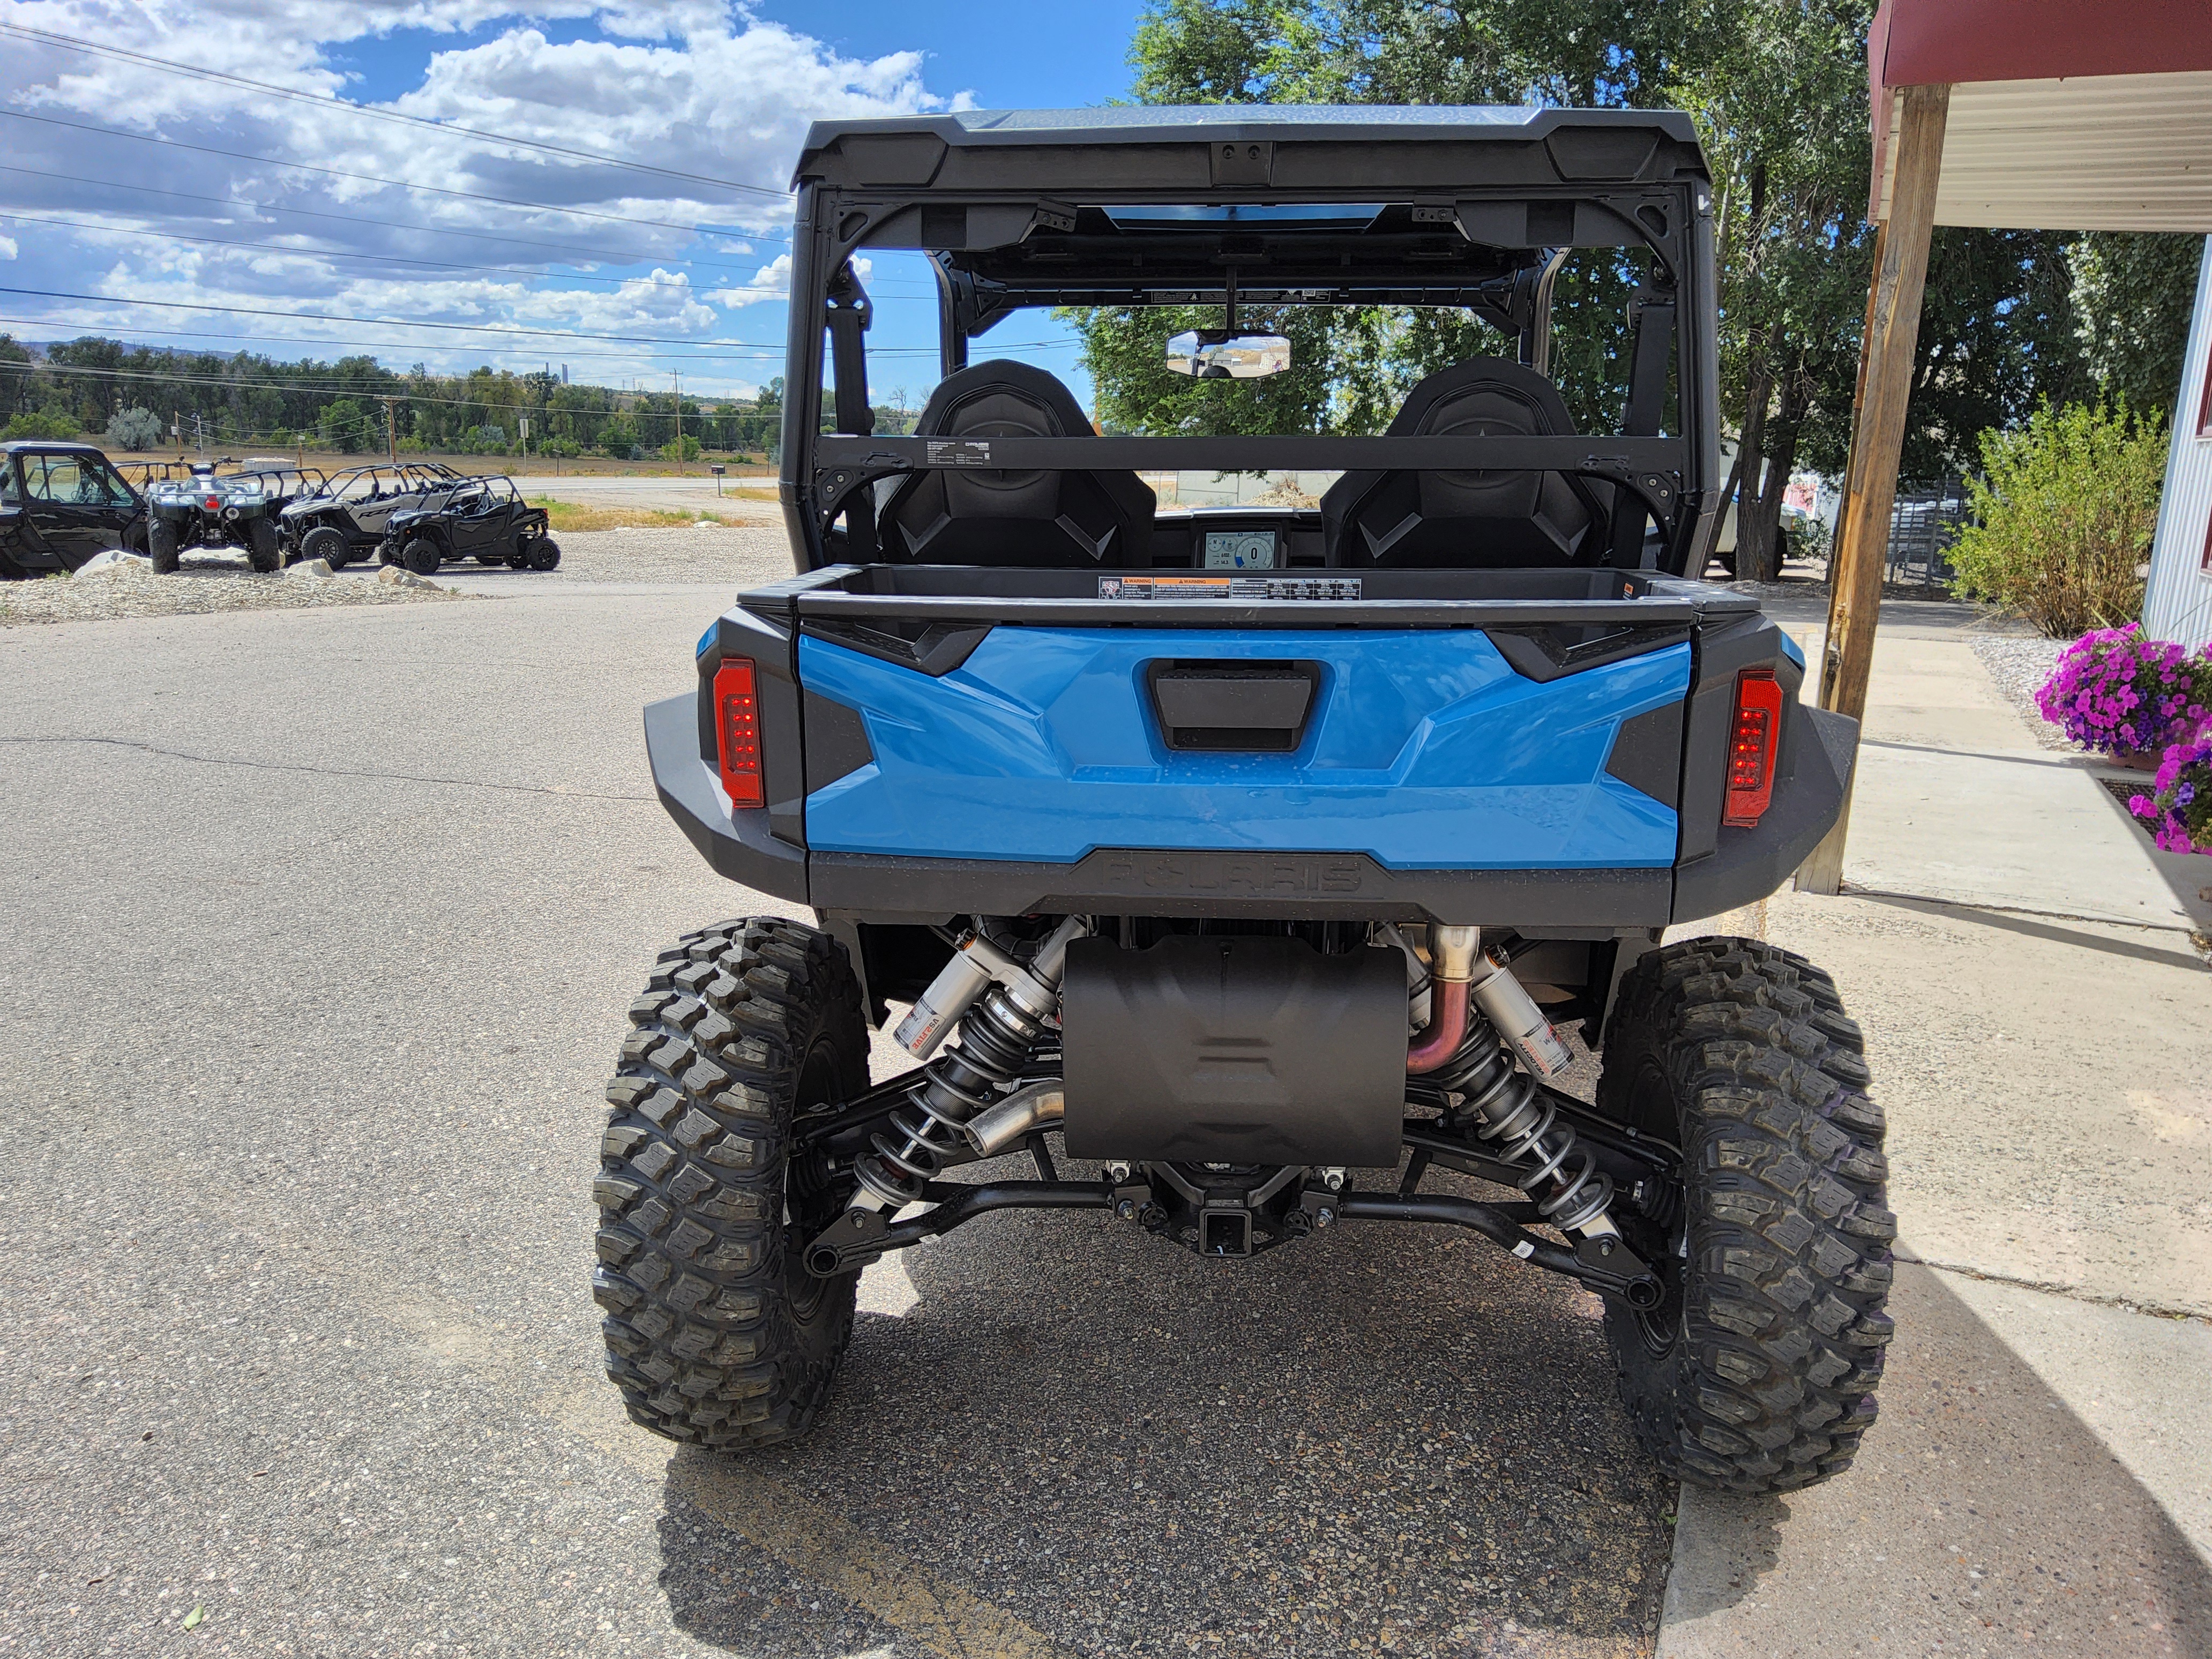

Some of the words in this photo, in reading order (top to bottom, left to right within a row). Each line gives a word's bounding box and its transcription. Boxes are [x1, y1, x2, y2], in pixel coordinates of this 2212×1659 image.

[357, 506, 401, 519] RZR
[1251, 547, 1258, 559] 0
[1102, 860, 1362, 892] POLARIS
[1518, 1043, 1545, 1076] VELOCITY
[1522, 1040, 1551, 1074] SERIES
